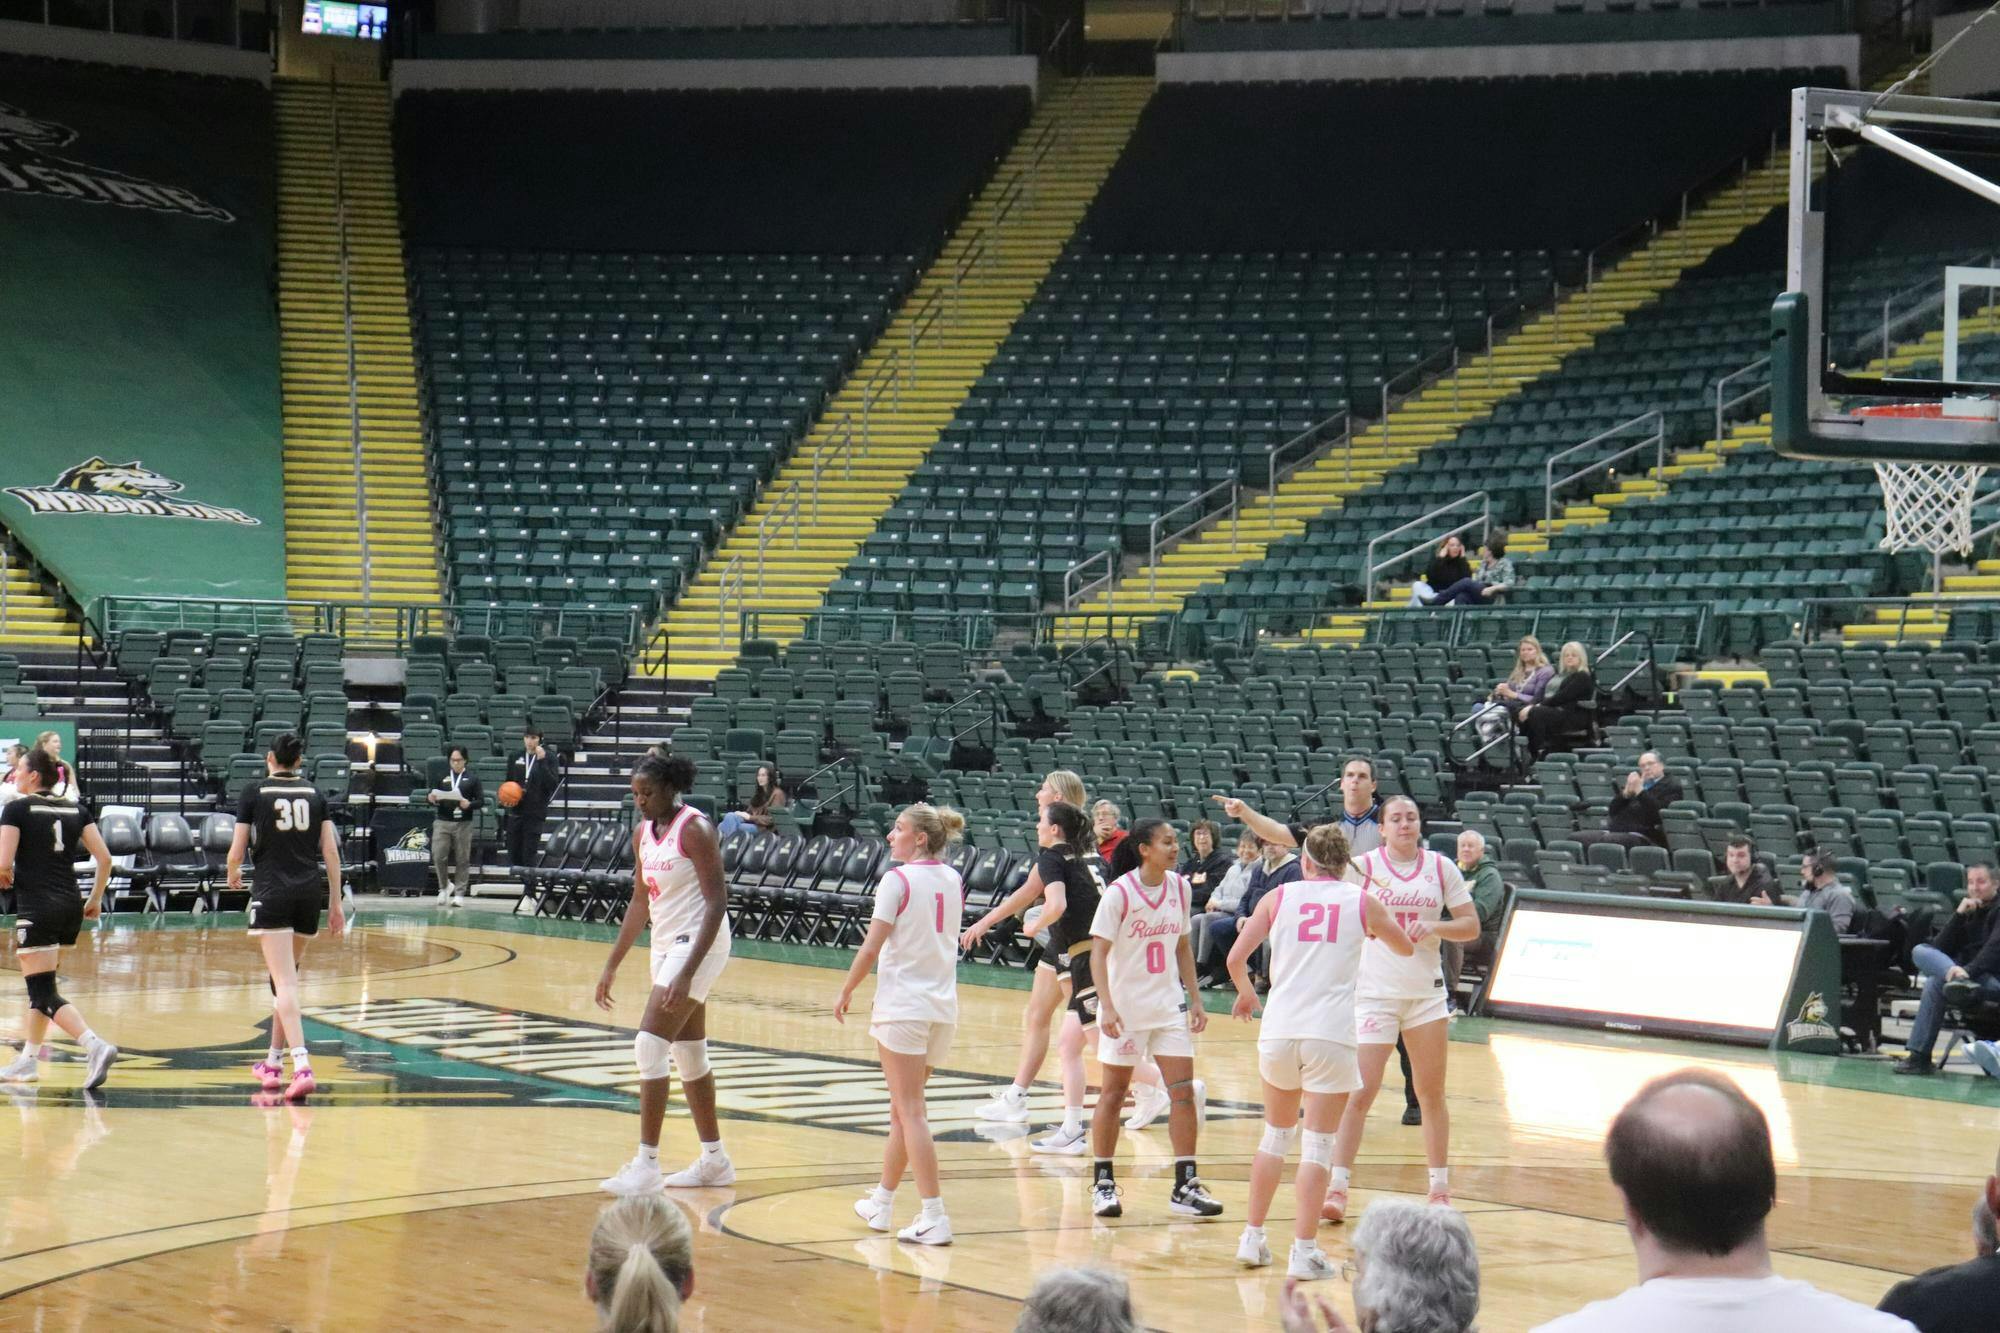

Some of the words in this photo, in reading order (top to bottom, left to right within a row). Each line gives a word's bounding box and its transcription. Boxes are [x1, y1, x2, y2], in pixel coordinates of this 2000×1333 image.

[15, 489, 166, 515] WRIGHT
[160, 501, 256, 523] STATE
[273, 798, 311, 832] 30
[53, 819, 65, 852] 1
[1086, 864, 1107, 897] 5
[935, 892, 945, 934] 1
[1375, 888, 1438, 908] Raiders
[1127, 917, 1182, 939] Raders
[1298, 903, 1341, 944] 21
[1146, 941, 1166, 974] 0
